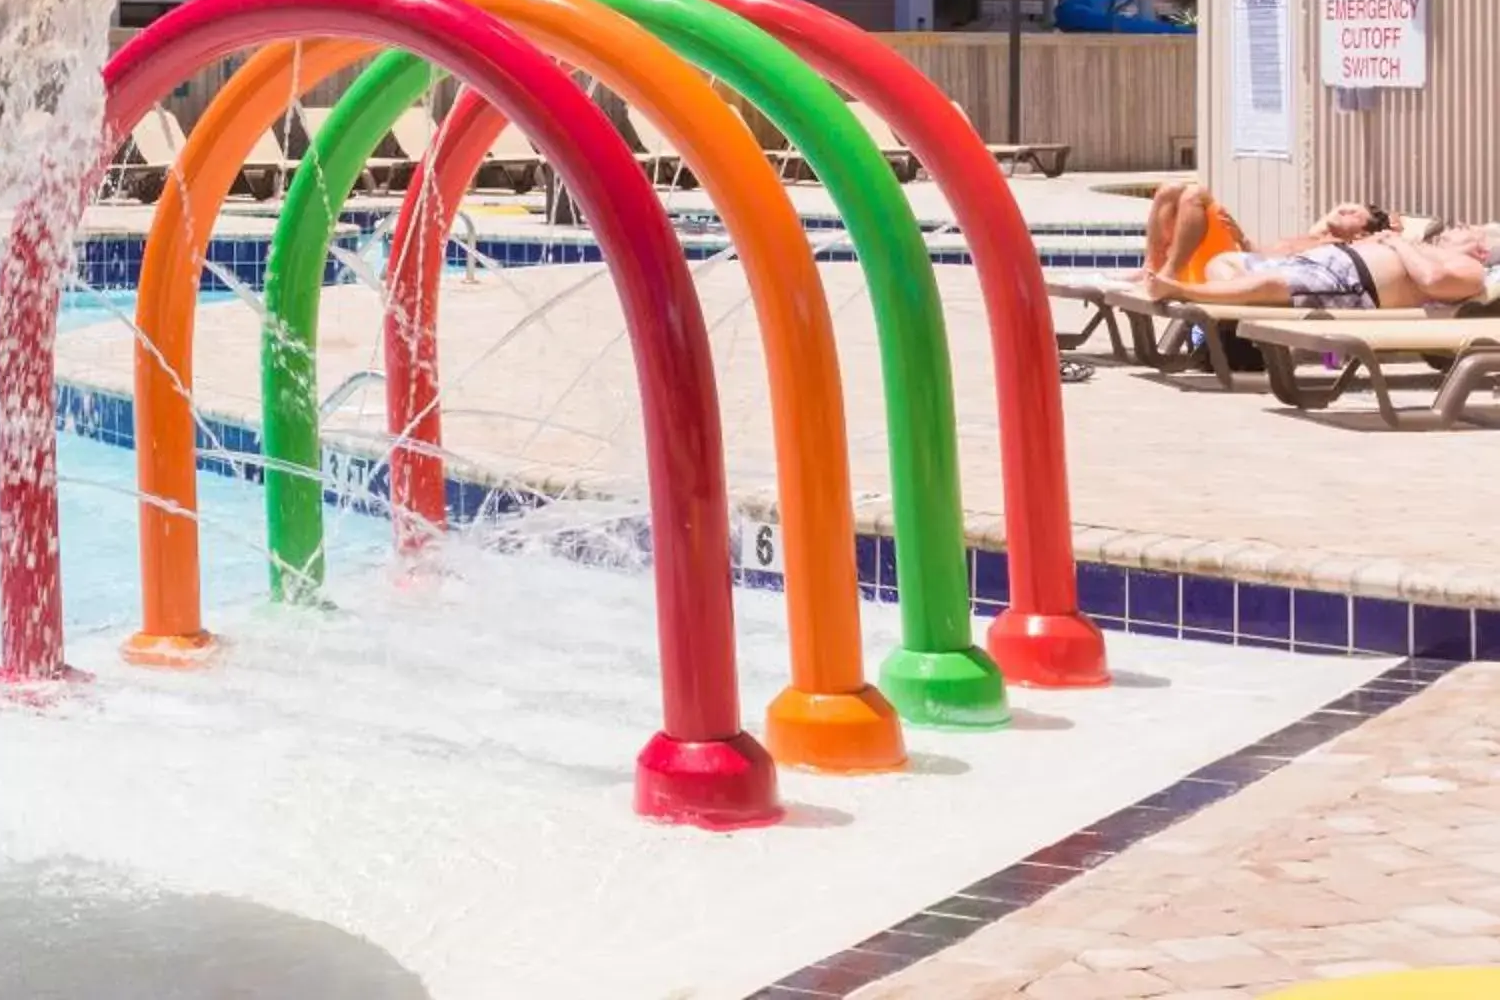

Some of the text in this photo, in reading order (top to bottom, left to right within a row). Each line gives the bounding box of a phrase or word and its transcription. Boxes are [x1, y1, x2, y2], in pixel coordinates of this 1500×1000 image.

[1341, 27, 1402, 50] CUTOFF
[1342, 55, 1401, 80] SWITCH
[755, 525, 774, 567] 6
